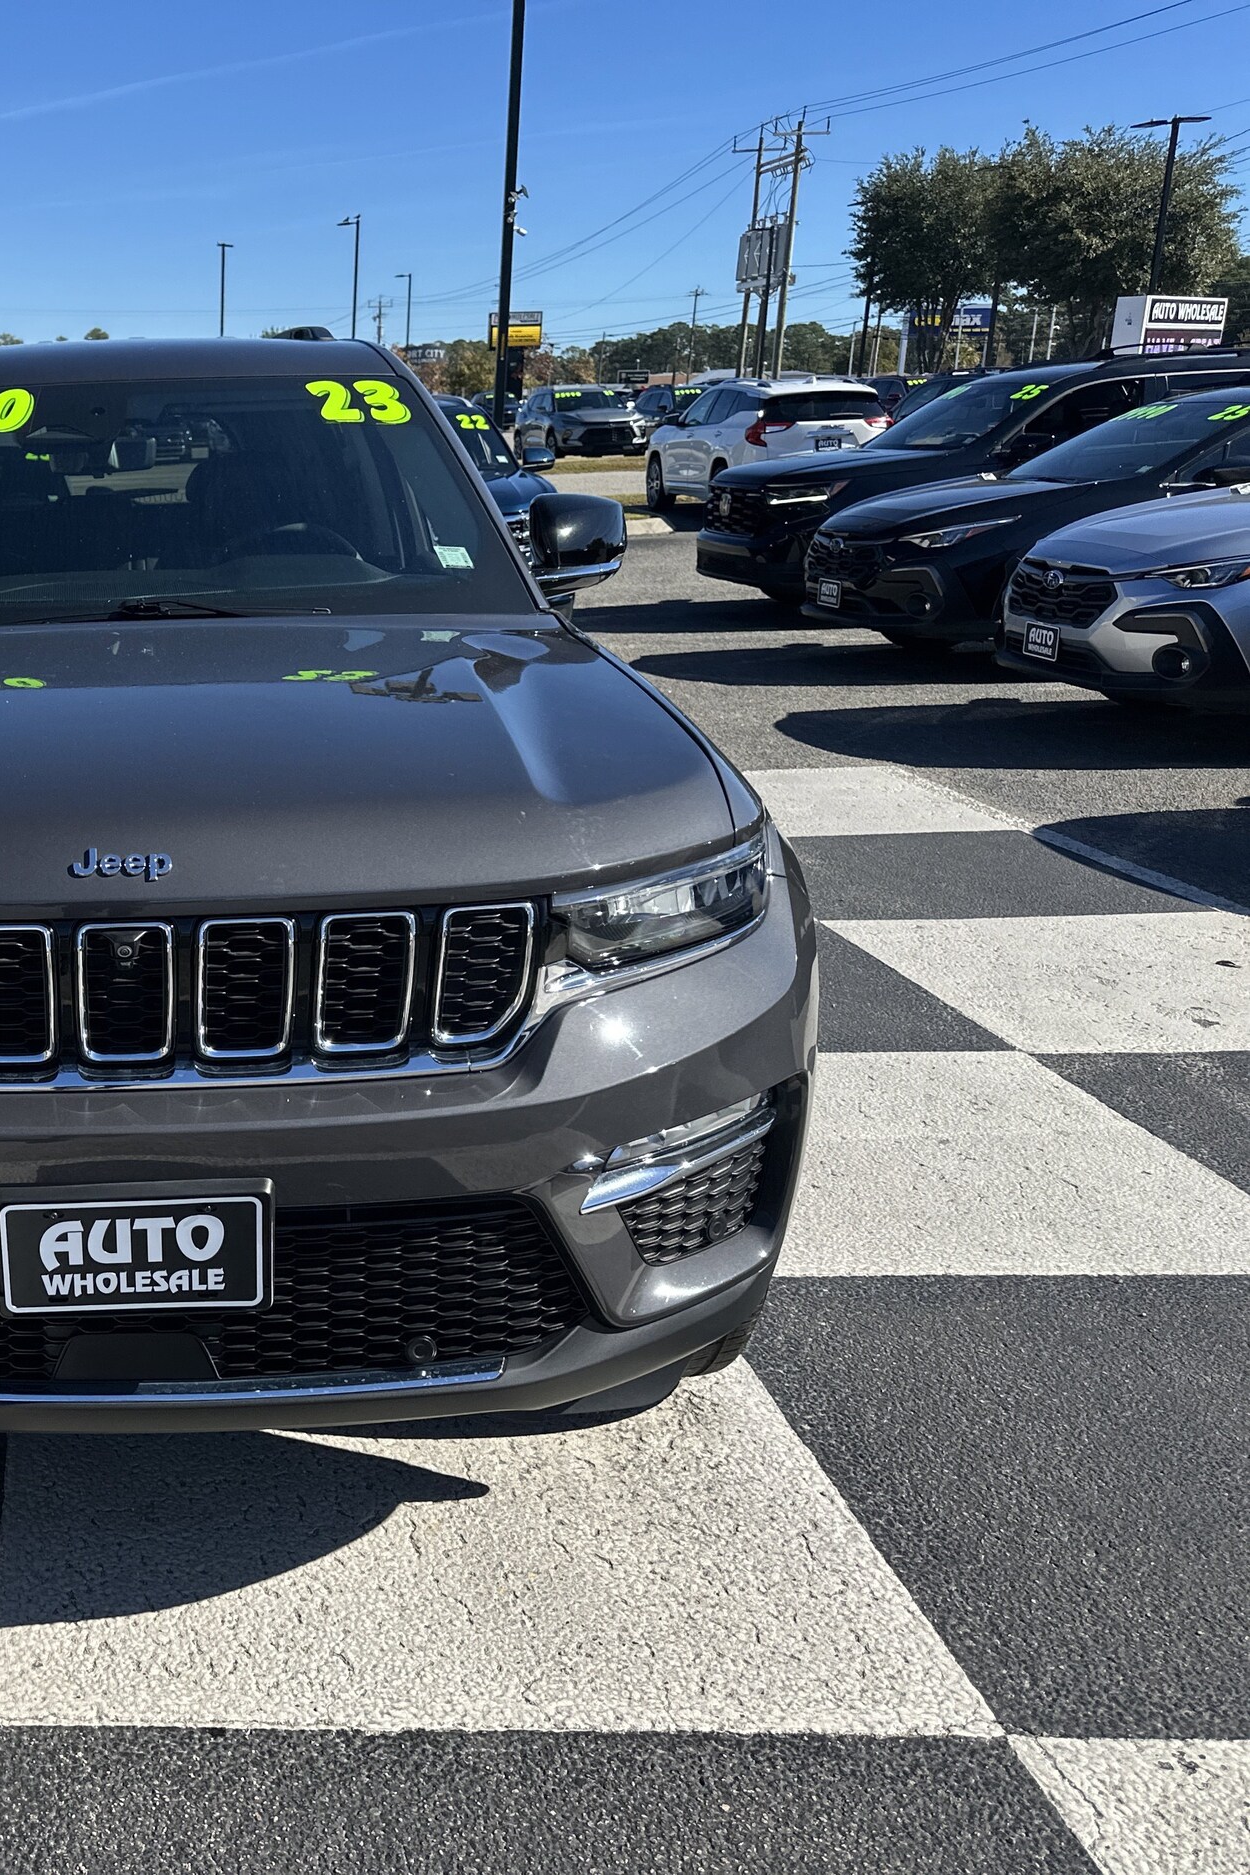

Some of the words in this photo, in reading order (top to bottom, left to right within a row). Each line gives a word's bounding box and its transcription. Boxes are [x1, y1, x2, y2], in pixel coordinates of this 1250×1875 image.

[1152, 302, 1176, 320] AUTO
[1178, 303, 1224, 322] WHOLESALE
[425, 349, 445, 358] CITY
[1009, 384, 1050, 400] 25
[305, 380, 412, 424] 23
[455, 414, 490, 430] 22
[818, 439, 839, 448] AUTO
[820, 582, 838, 596] AUTO
[1029, 627, 1054, 646] AUTO
[70, 848, 173, 882] Jeep
[39, 1214, 225, 1272] AUTO
[41, 1267, 225, 1297] WHOLESALE
